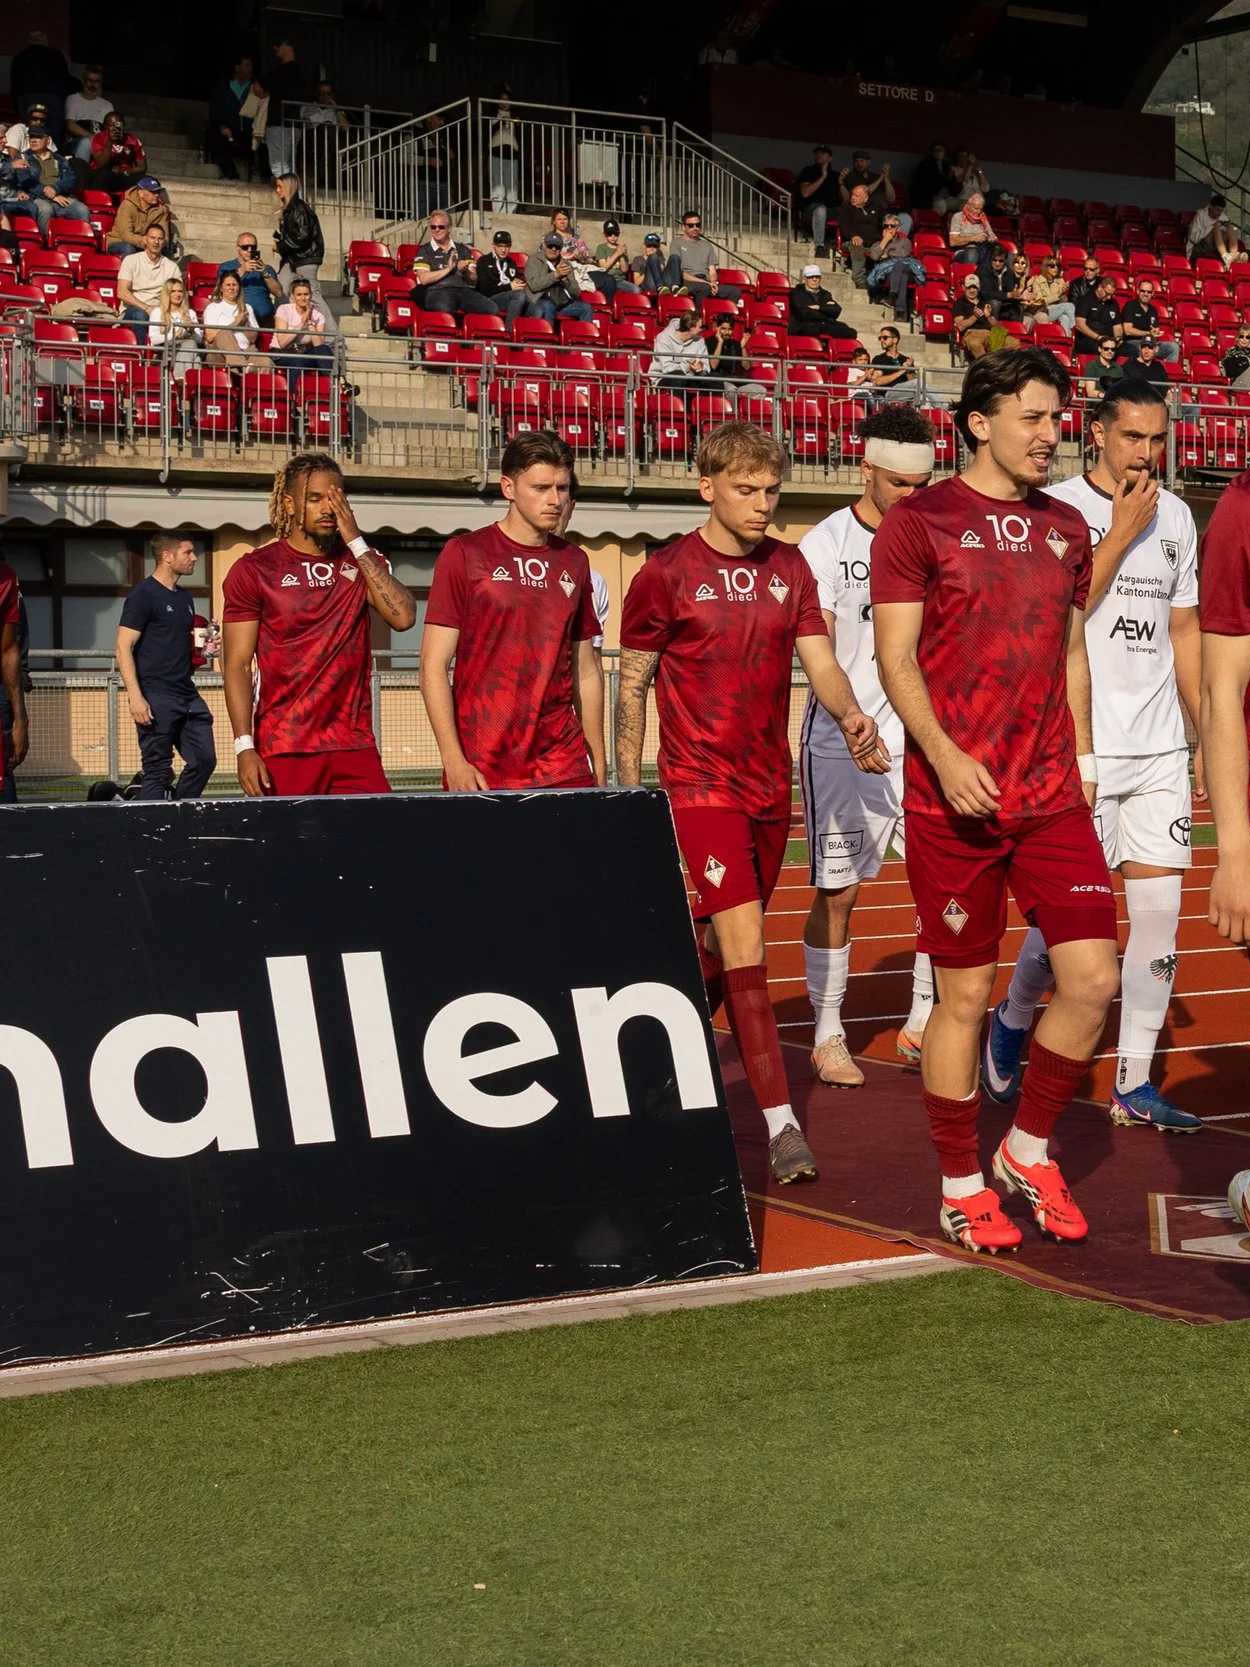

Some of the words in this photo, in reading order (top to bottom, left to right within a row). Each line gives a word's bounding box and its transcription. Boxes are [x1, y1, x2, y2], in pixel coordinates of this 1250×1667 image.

[859, 82, 919, 101] SETTORE
[925, 90, 935, 102] D
[997, 540, 1033, 552] dieci
[308, 577, 336, 588] dieci
[520, 577, 548, 589] dieci
[844, 580, 869, 589] diec
[1117, 573, 1163, 587] Aargauische
[727, 591, 758, 602] dieci
[1109, 615, 1156, 642] AEW
